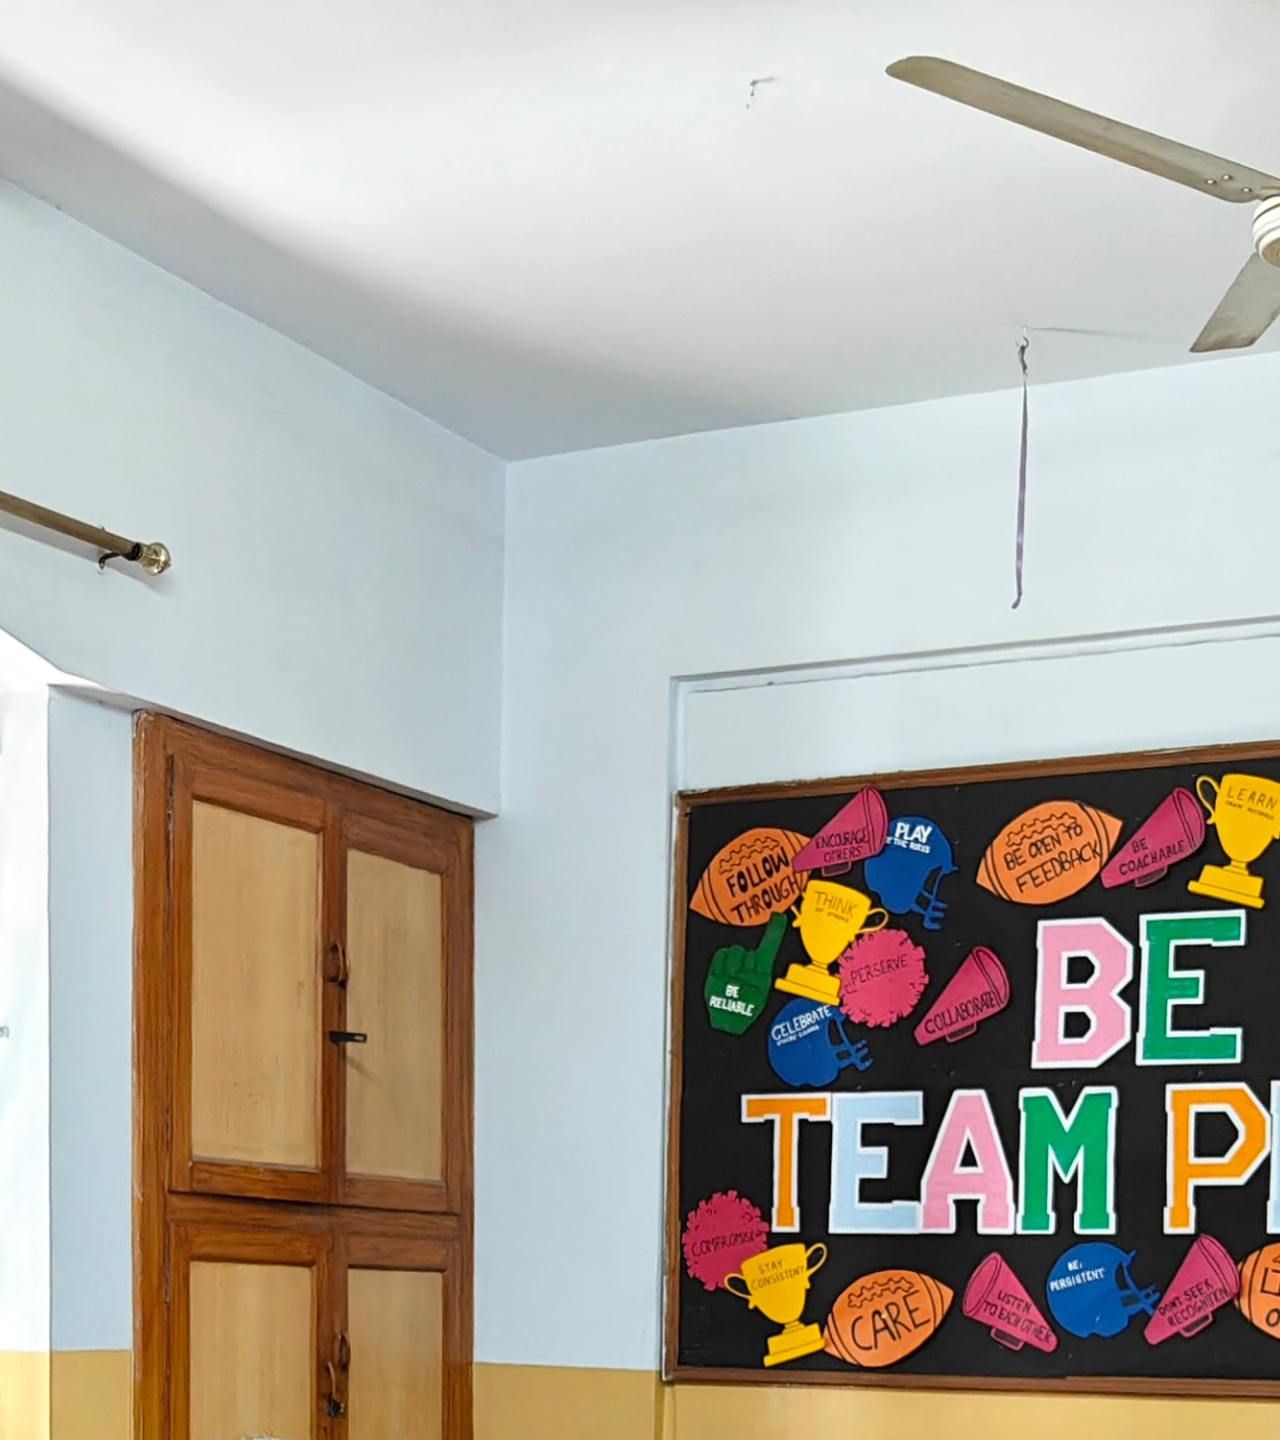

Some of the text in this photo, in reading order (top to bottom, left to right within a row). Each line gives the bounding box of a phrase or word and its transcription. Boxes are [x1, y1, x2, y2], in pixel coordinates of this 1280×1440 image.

[1226, 784, 1278, 810] LEARN
[815, 828, 870, 849] ENCOURAGE
[895, 822, 933, 843] PLAY
[1004, 823, 1084, 871] BE OPEN TO
[1131, 837, 1147, 854] BE
[823, 846, 862, 863] OTHERS
[1015, 839, 1100, 893] FEEDBACK
[1119, 839, 1186, 876] COACHABLE
[726, 847, 790, 898] FOLLOW
[730, 875, 801, 924] THROUGH
[814, 890, 859, 919] THINK
[724, 984, 740, 999] BE
[1031, 909, 1246, 1069] BE
[709, 996, 755, 1018] RELIABLE
[923, 991, 996, 1034] COLLABORATE
[770, 1003, 833, 1041] CELEBRATE
[740, 1086, 1119, 1235] TEAM
[750, 1264, 806, 1291] CONSISTENT
[758, 1257, 783, 1274] STAY
[1049, 1266, 1107, 1292] PERSISTENT
[995, 1288, 1032, 1314] LISTEN
[1182, 1277, 1214, 1300] SEEK
[1166, 1286, 1232, 1328] RECOGNITION
[850, 1295, 931, 1353] CARE
[982, 1301, 1053, 1345] TO EACH OTHER
